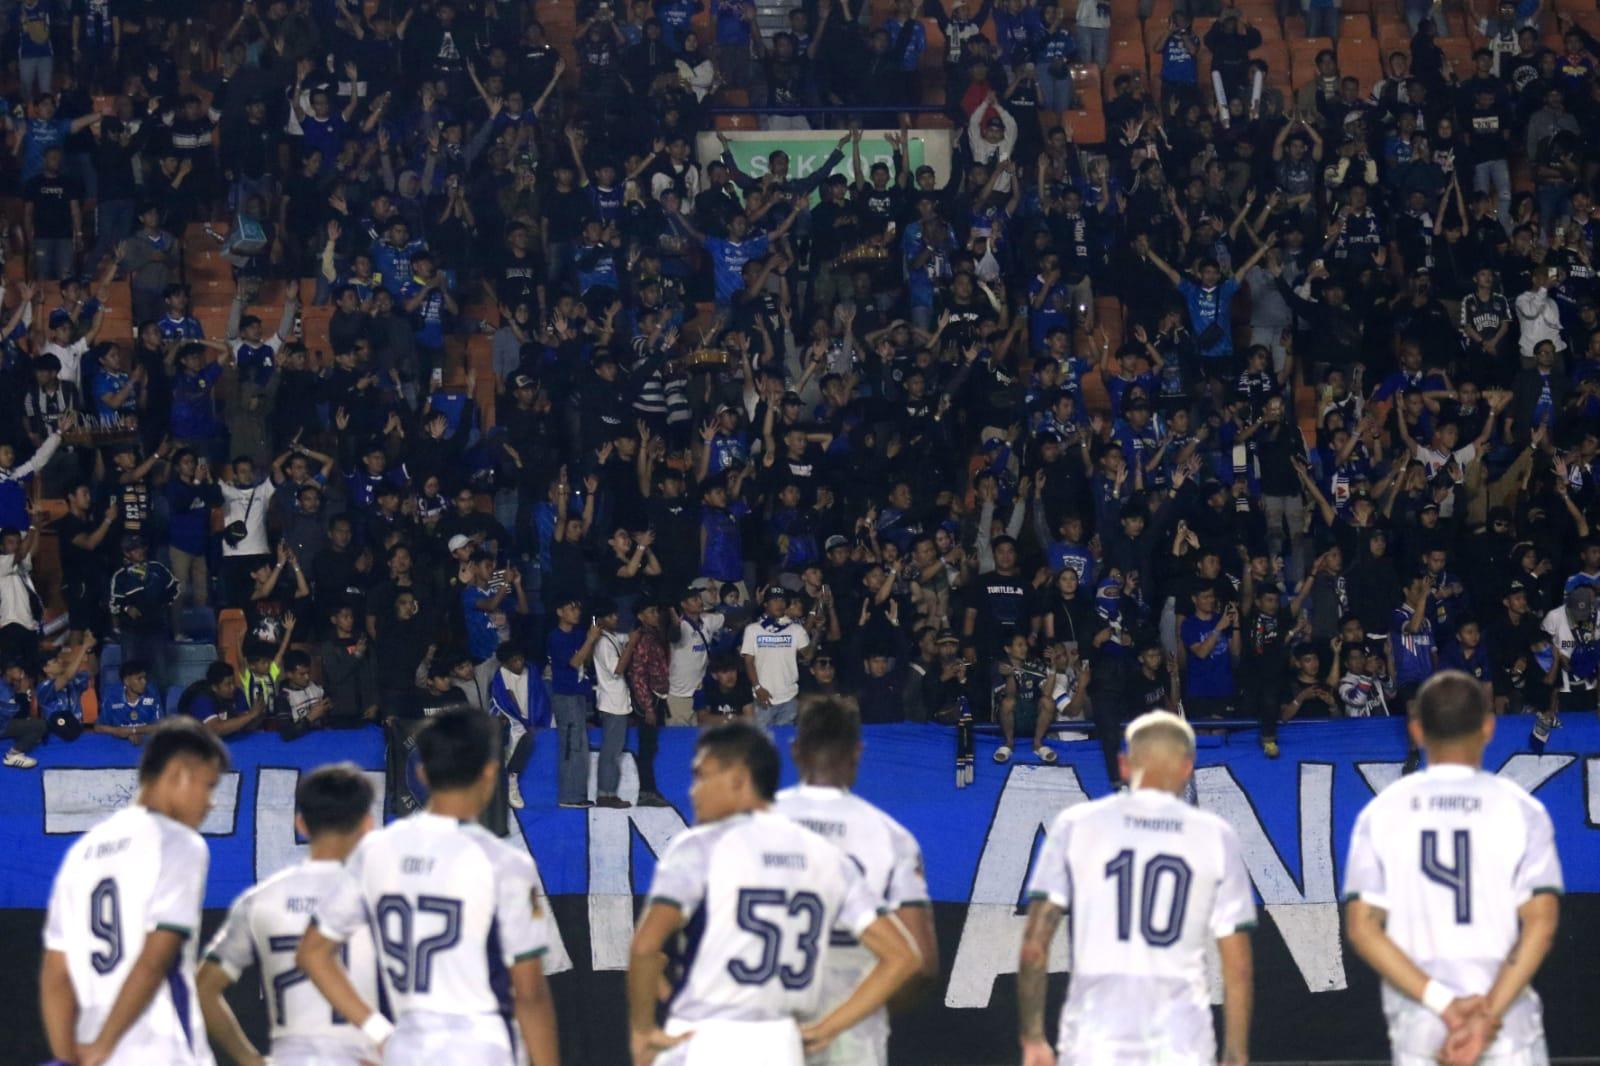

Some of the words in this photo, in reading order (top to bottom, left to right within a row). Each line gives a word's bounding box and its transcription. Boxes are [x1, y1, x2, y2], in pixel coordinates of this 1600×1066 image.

[750, 154, 897, 180] SKOR
[90, 877, 124, 975] 9
[1104, 848, 1193, 948] 10
[1420, 829, 1471, 925] 4
[375, 894, 463, 994] 97
[726, 887, 825, 991] 53
